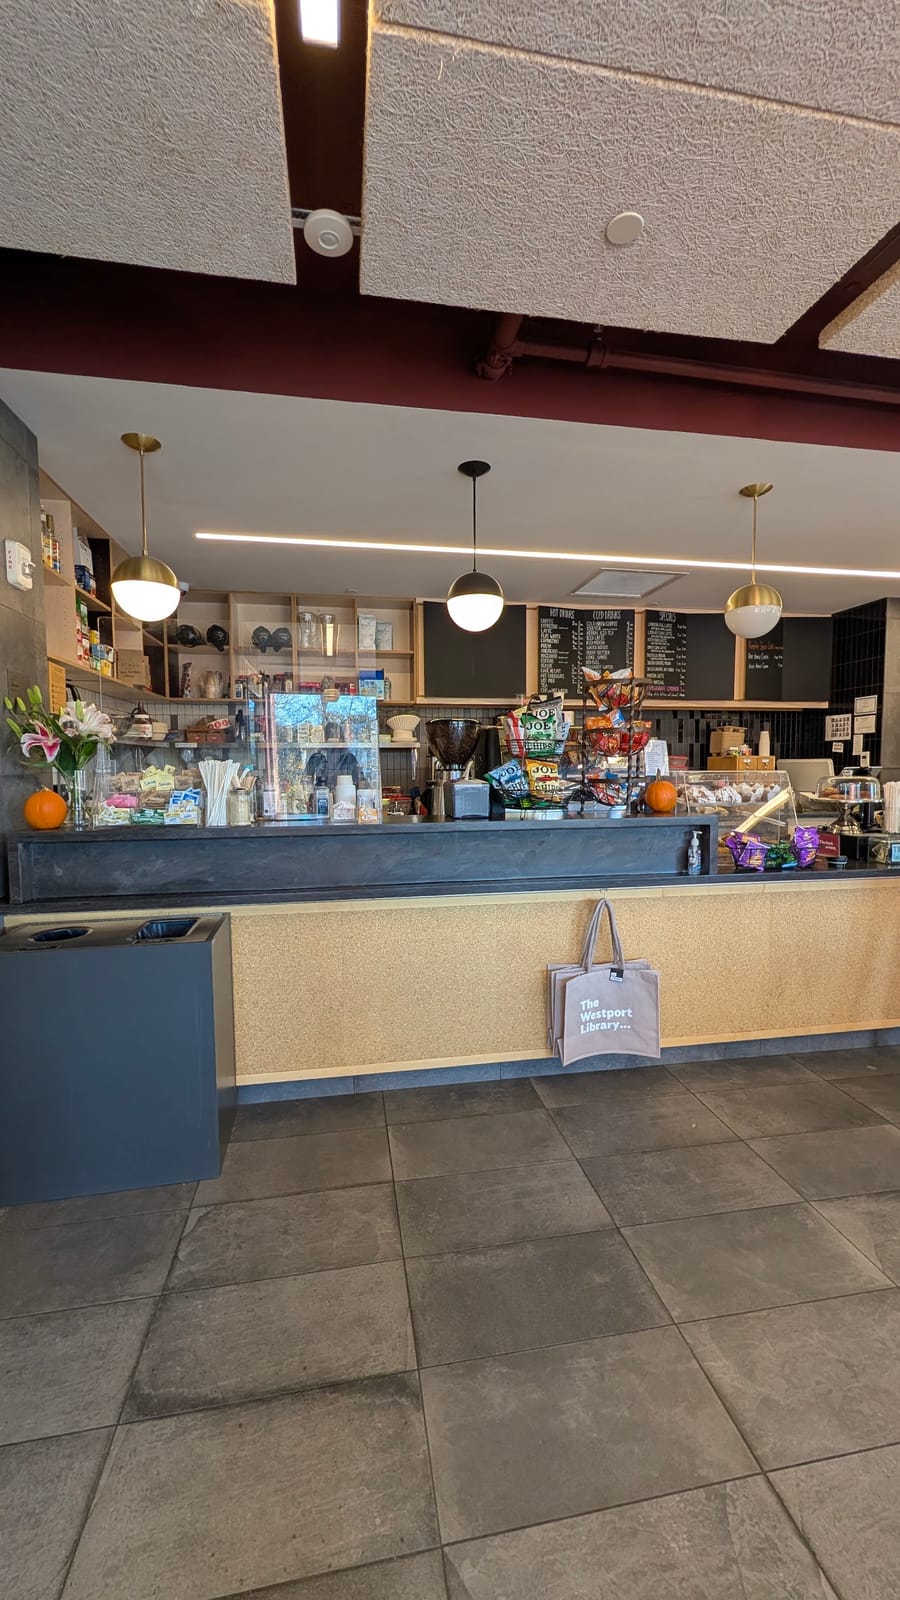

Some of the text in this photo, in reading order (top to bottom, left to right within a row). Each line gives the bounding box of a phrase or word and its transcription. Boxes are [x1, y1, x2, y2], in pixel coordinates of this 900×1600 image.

[550, 608, 575, 619] HOT DRINKS
[593, 611, 621, 620] COLD DRINKS
[526, 721, 551, 731] JOE
[532, 766, 558, 774] JOE
[580, 999, 599, 1011] The
[580, 1008, 633, 1023] Westport
